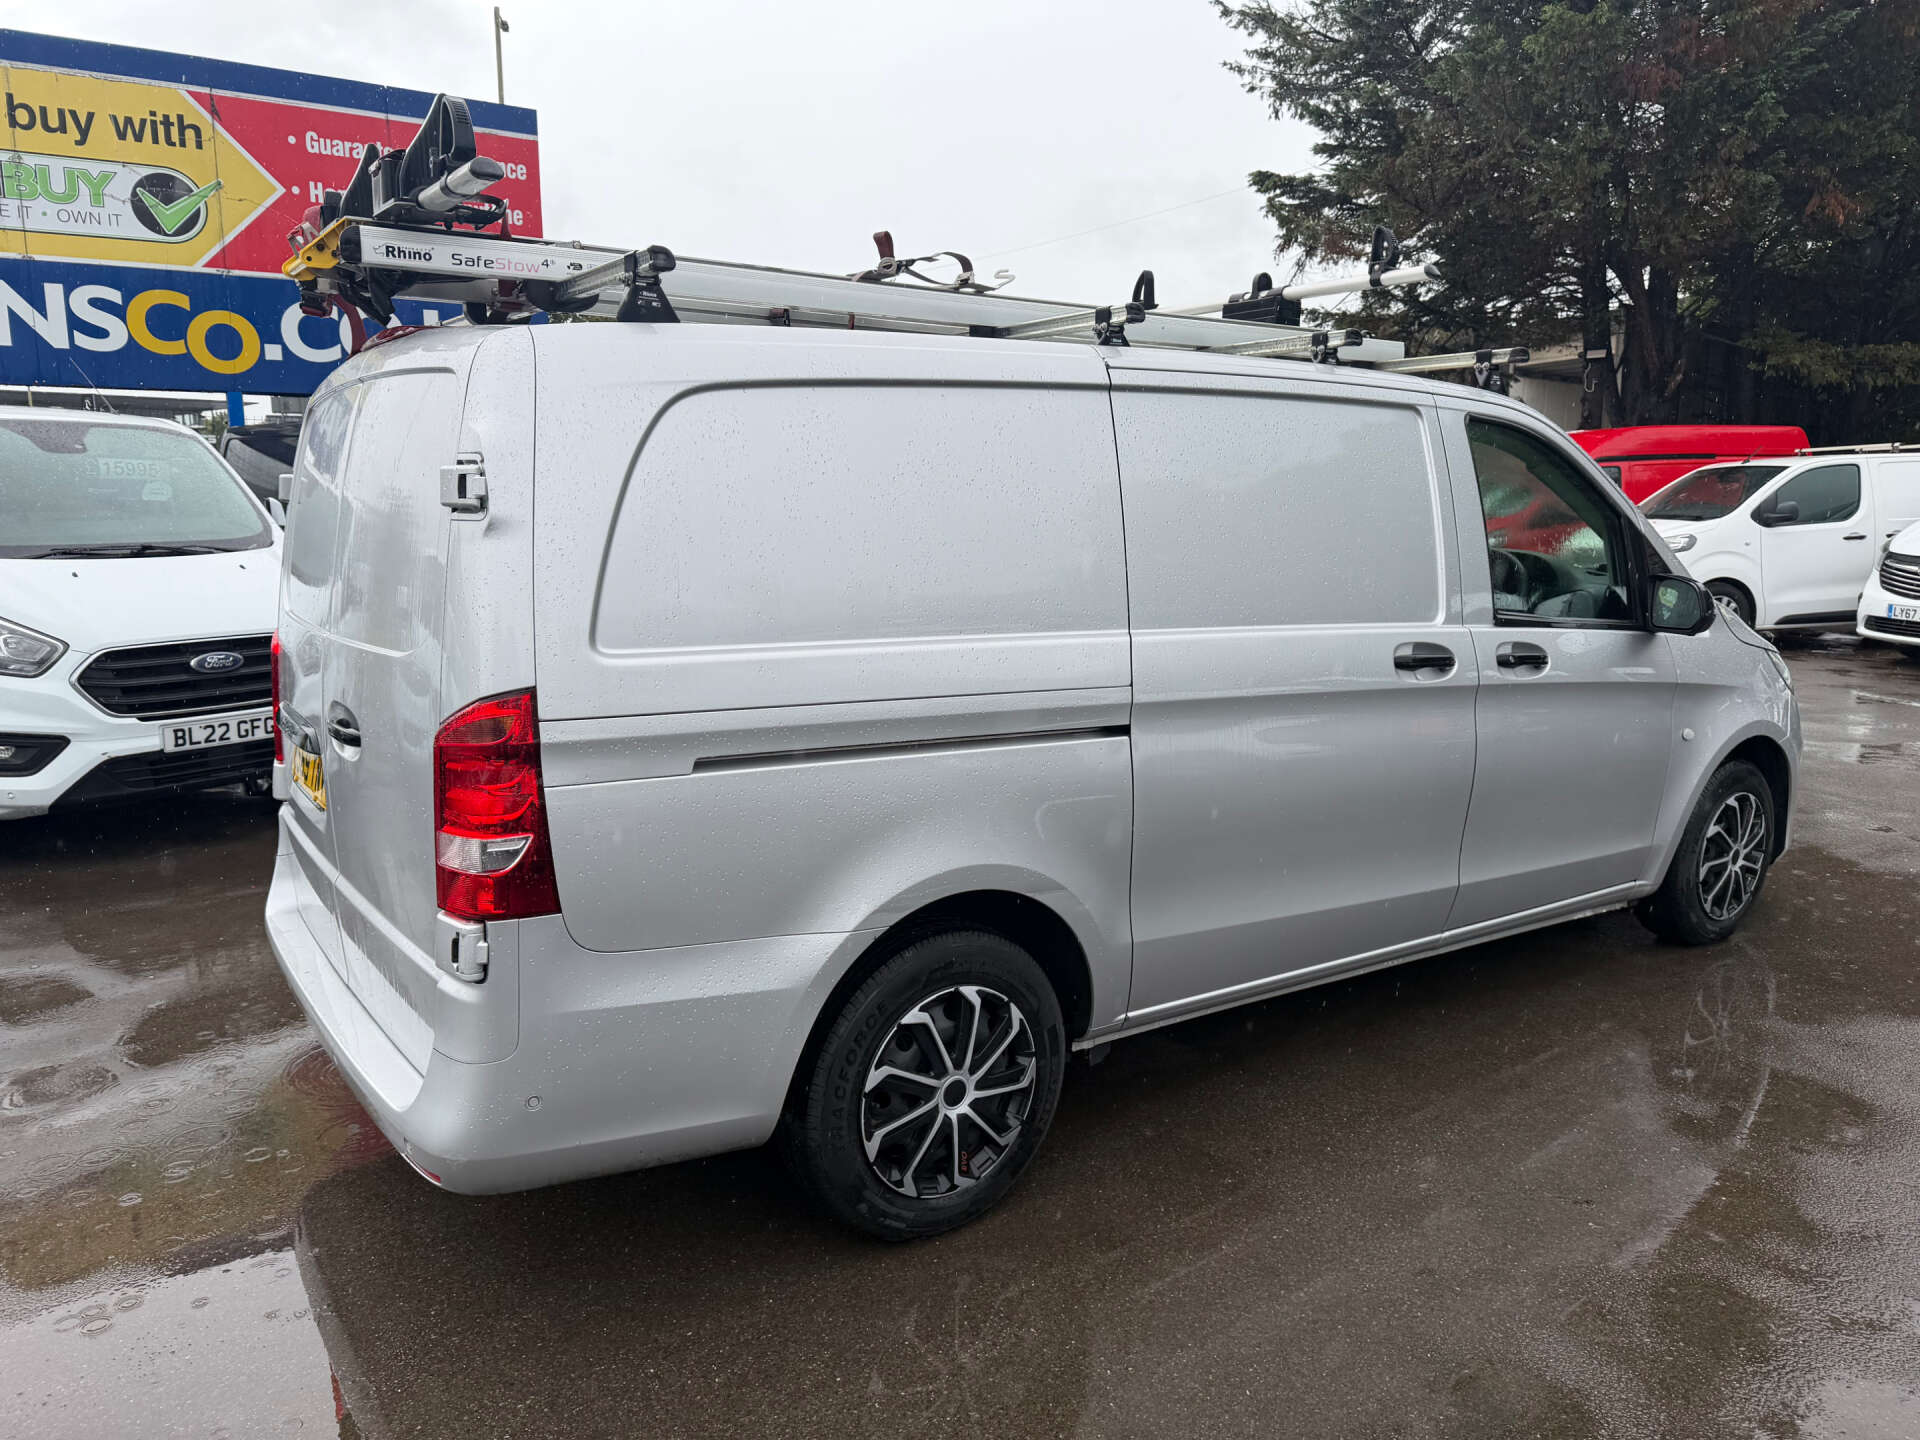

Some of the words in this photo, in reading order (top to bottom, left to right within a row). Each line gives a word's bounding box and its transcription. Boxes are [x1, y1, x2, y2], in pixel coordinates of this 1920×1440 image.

[5, 92, 96, 146] buy
[109, 110, 204, 150] with
[1, 160, 117, 208] BUY
[17, 205, 32, 219] IT
[57, 208, 102, 226] OWN
[108, 213, 122, 227] IT
[385, 244, 433, 262] Rhino
[1894, 607, 1917, 619] LY67
[204, 654, 234, 668] Ford
[173, 722, 231, 748] BL22
[237, 716, 275, 739] GFG
